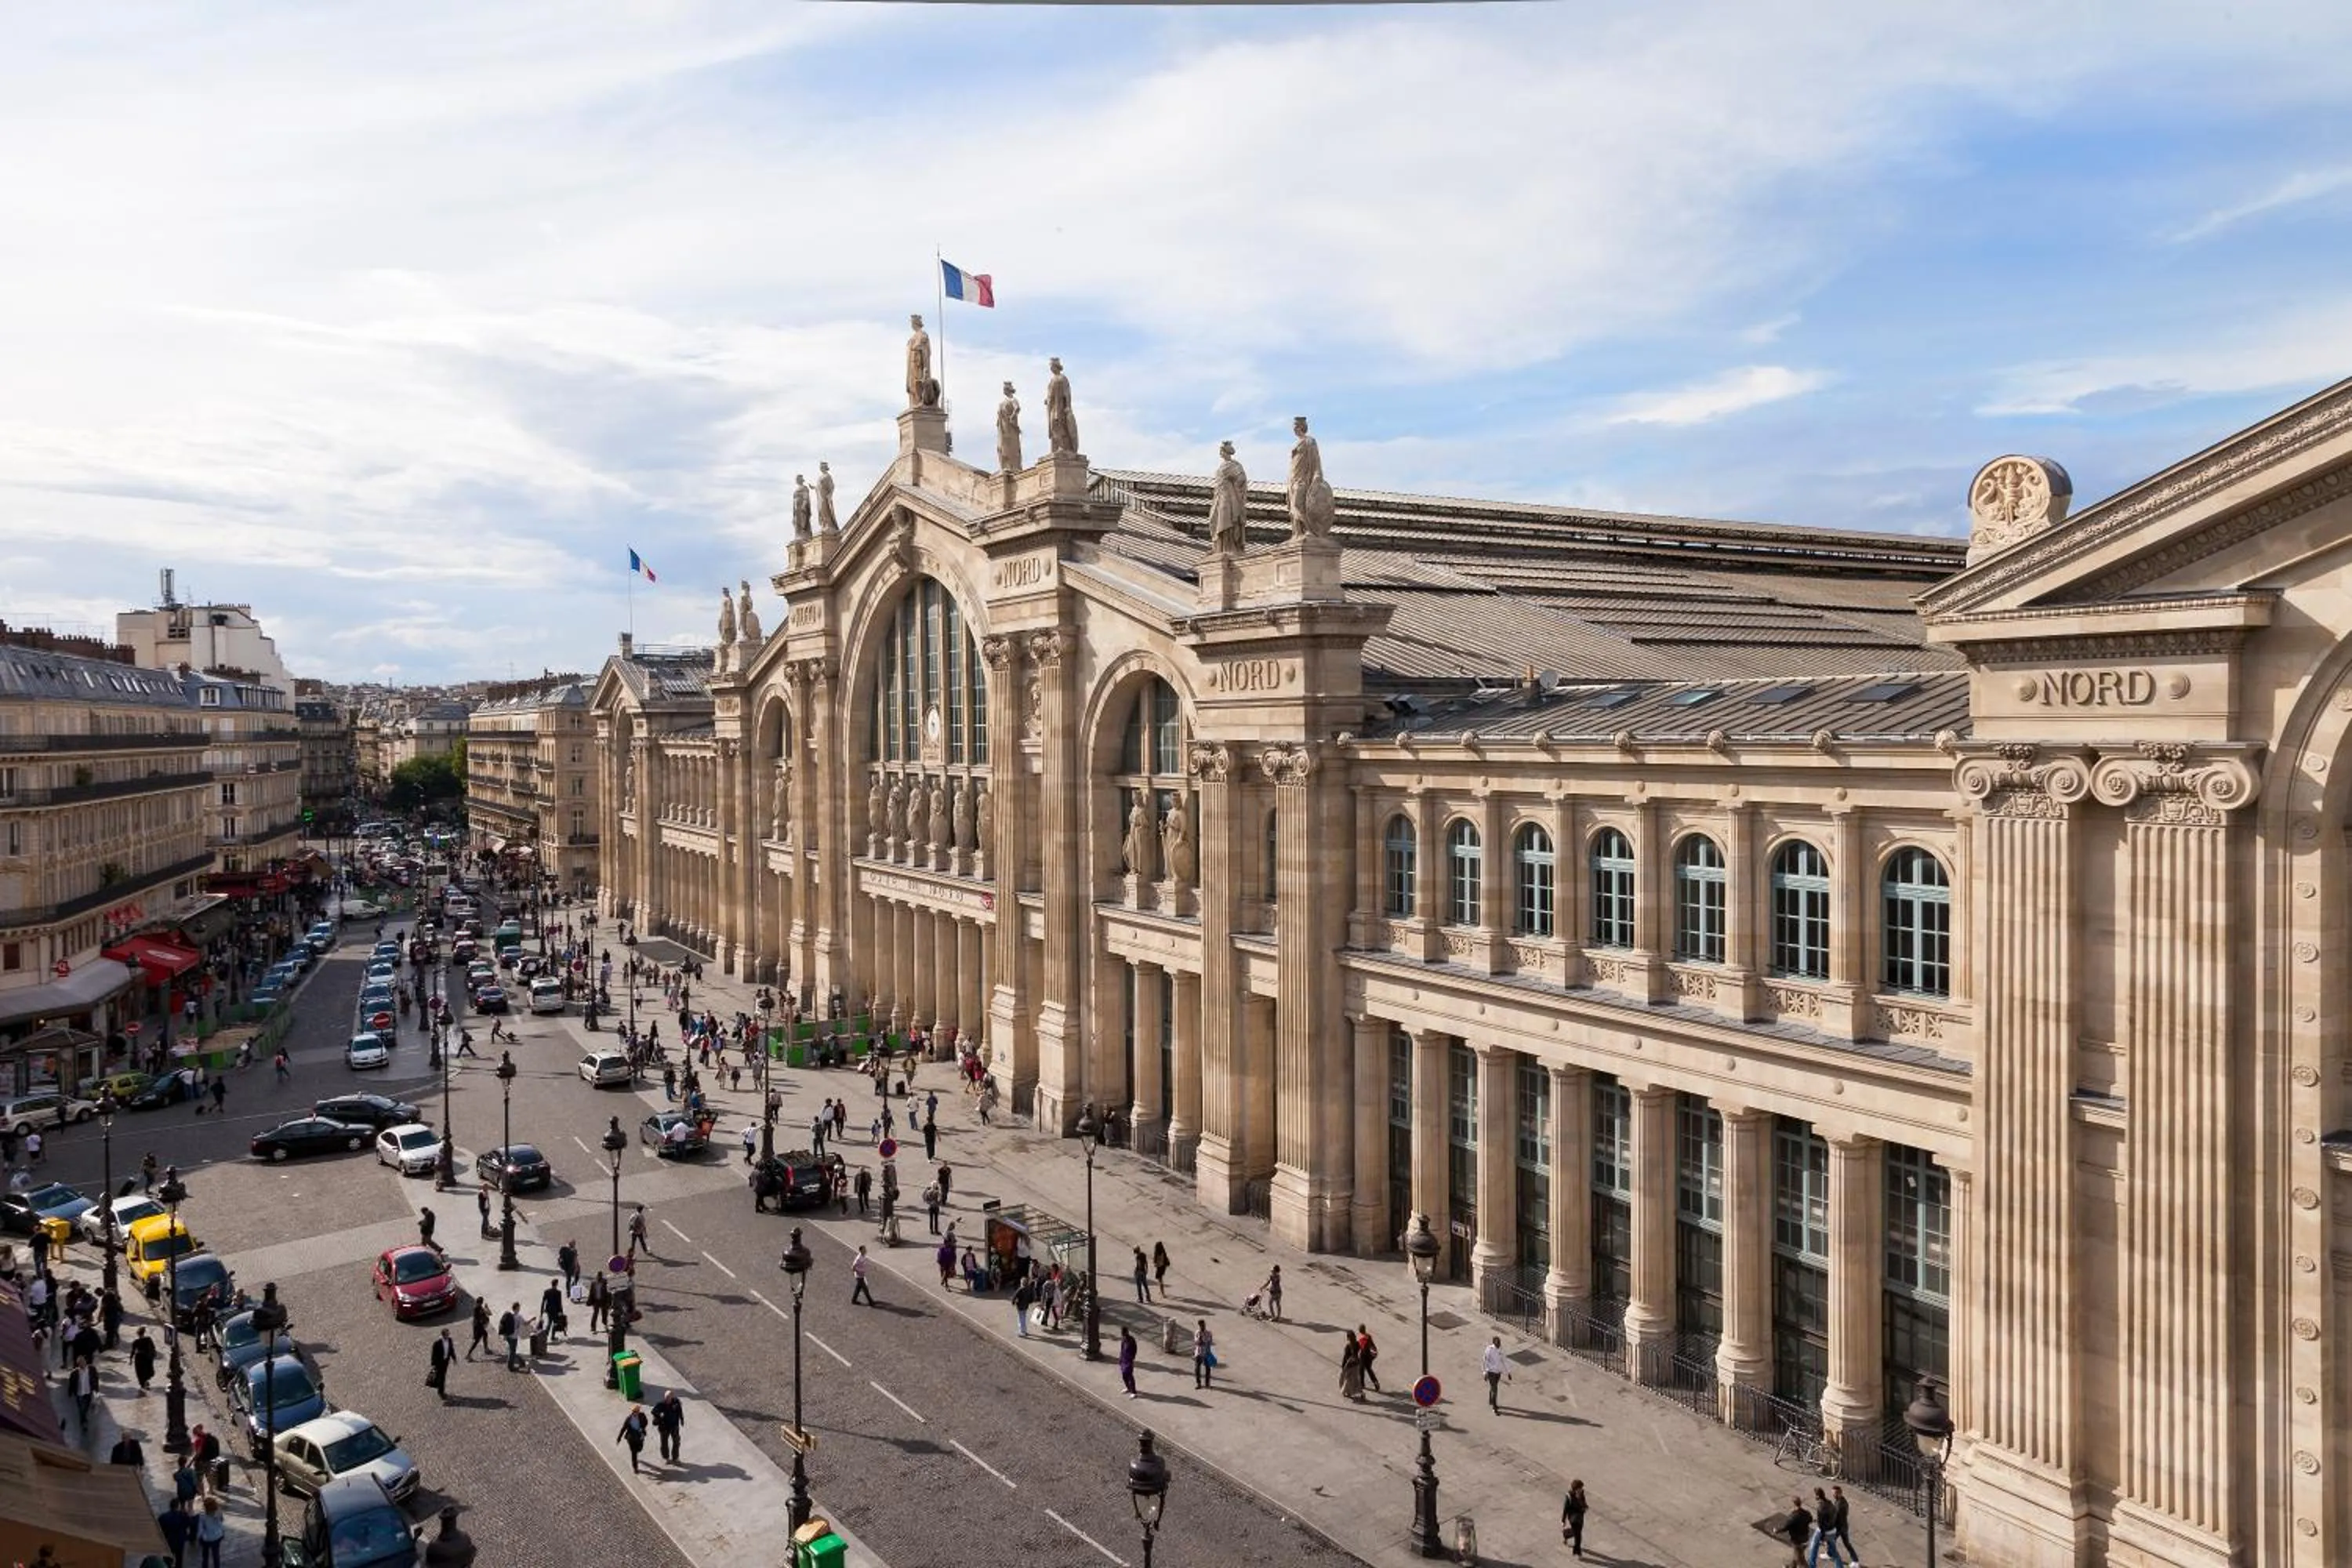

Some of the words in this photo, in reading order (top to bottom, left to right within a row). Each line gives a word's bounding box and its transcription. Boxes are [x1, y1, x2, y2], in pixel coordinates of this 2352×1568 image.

[1003, 557, 1040, 588] NORD
[1219, 660, 1280, 692] NORD
[2041, 670, 2157, 706] NORD
